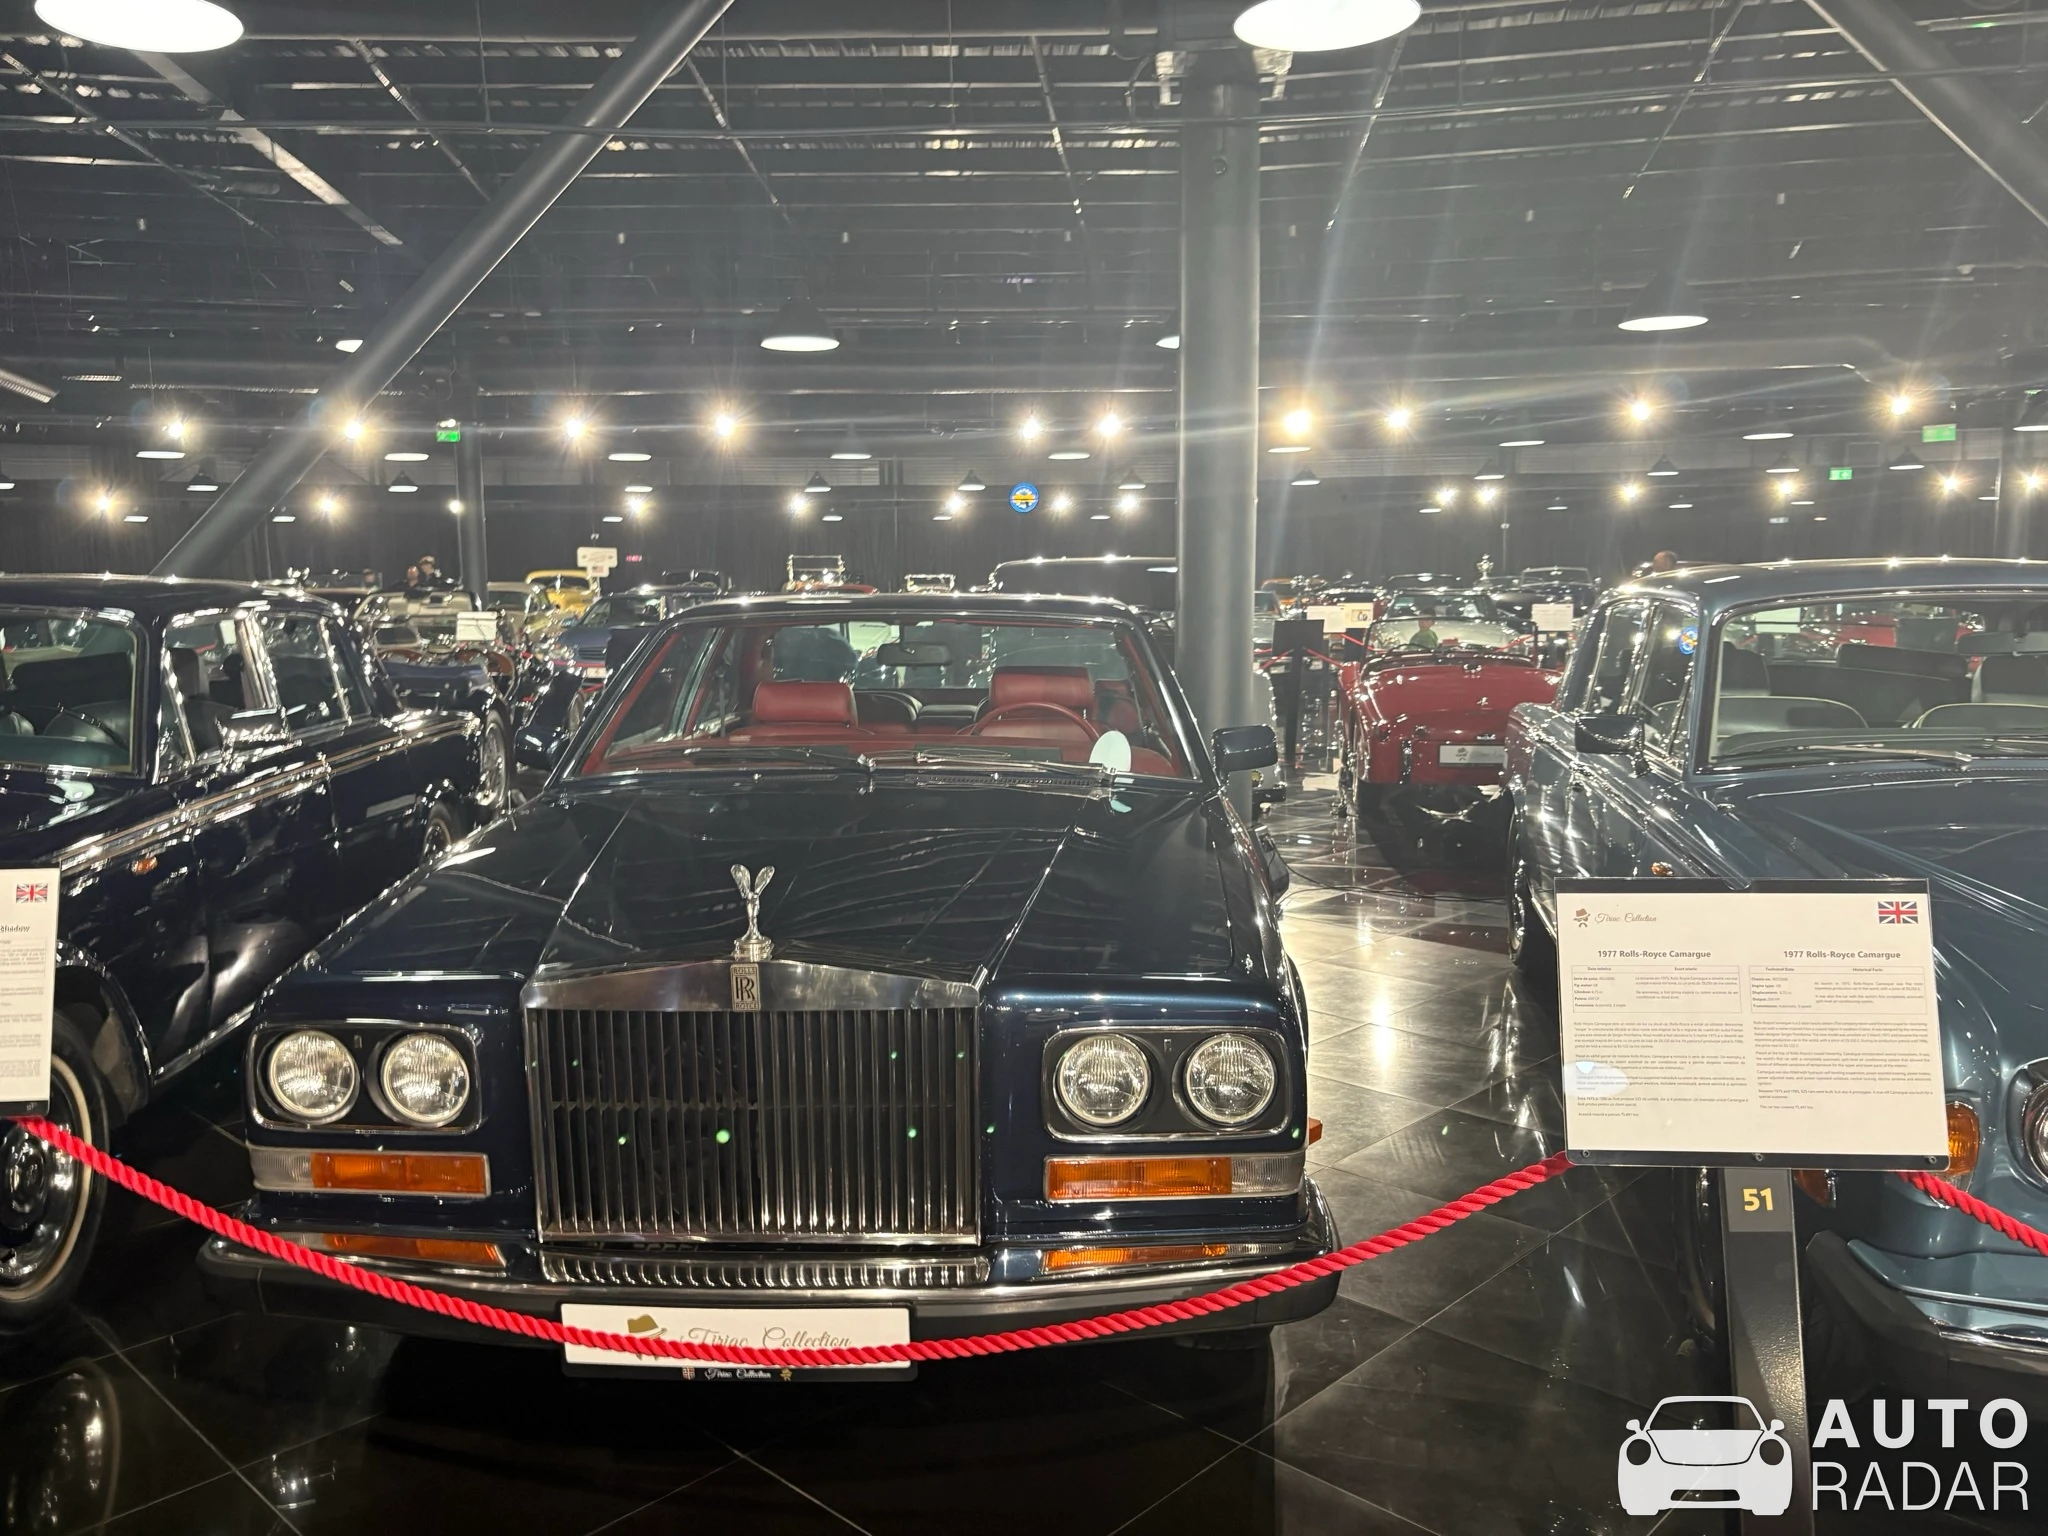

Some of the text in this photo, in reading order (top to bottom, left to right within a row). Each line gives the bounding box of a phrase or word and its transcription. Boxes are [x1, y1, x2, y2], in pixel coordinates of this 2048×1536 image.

[1598, 950, 1712, 960] 1977 Rolls-Royce Camargue
[1783, 950, 1901, 960] 1977 Rolls-Royce Camargue
[1743, 1187, 1774, 1212] 51
